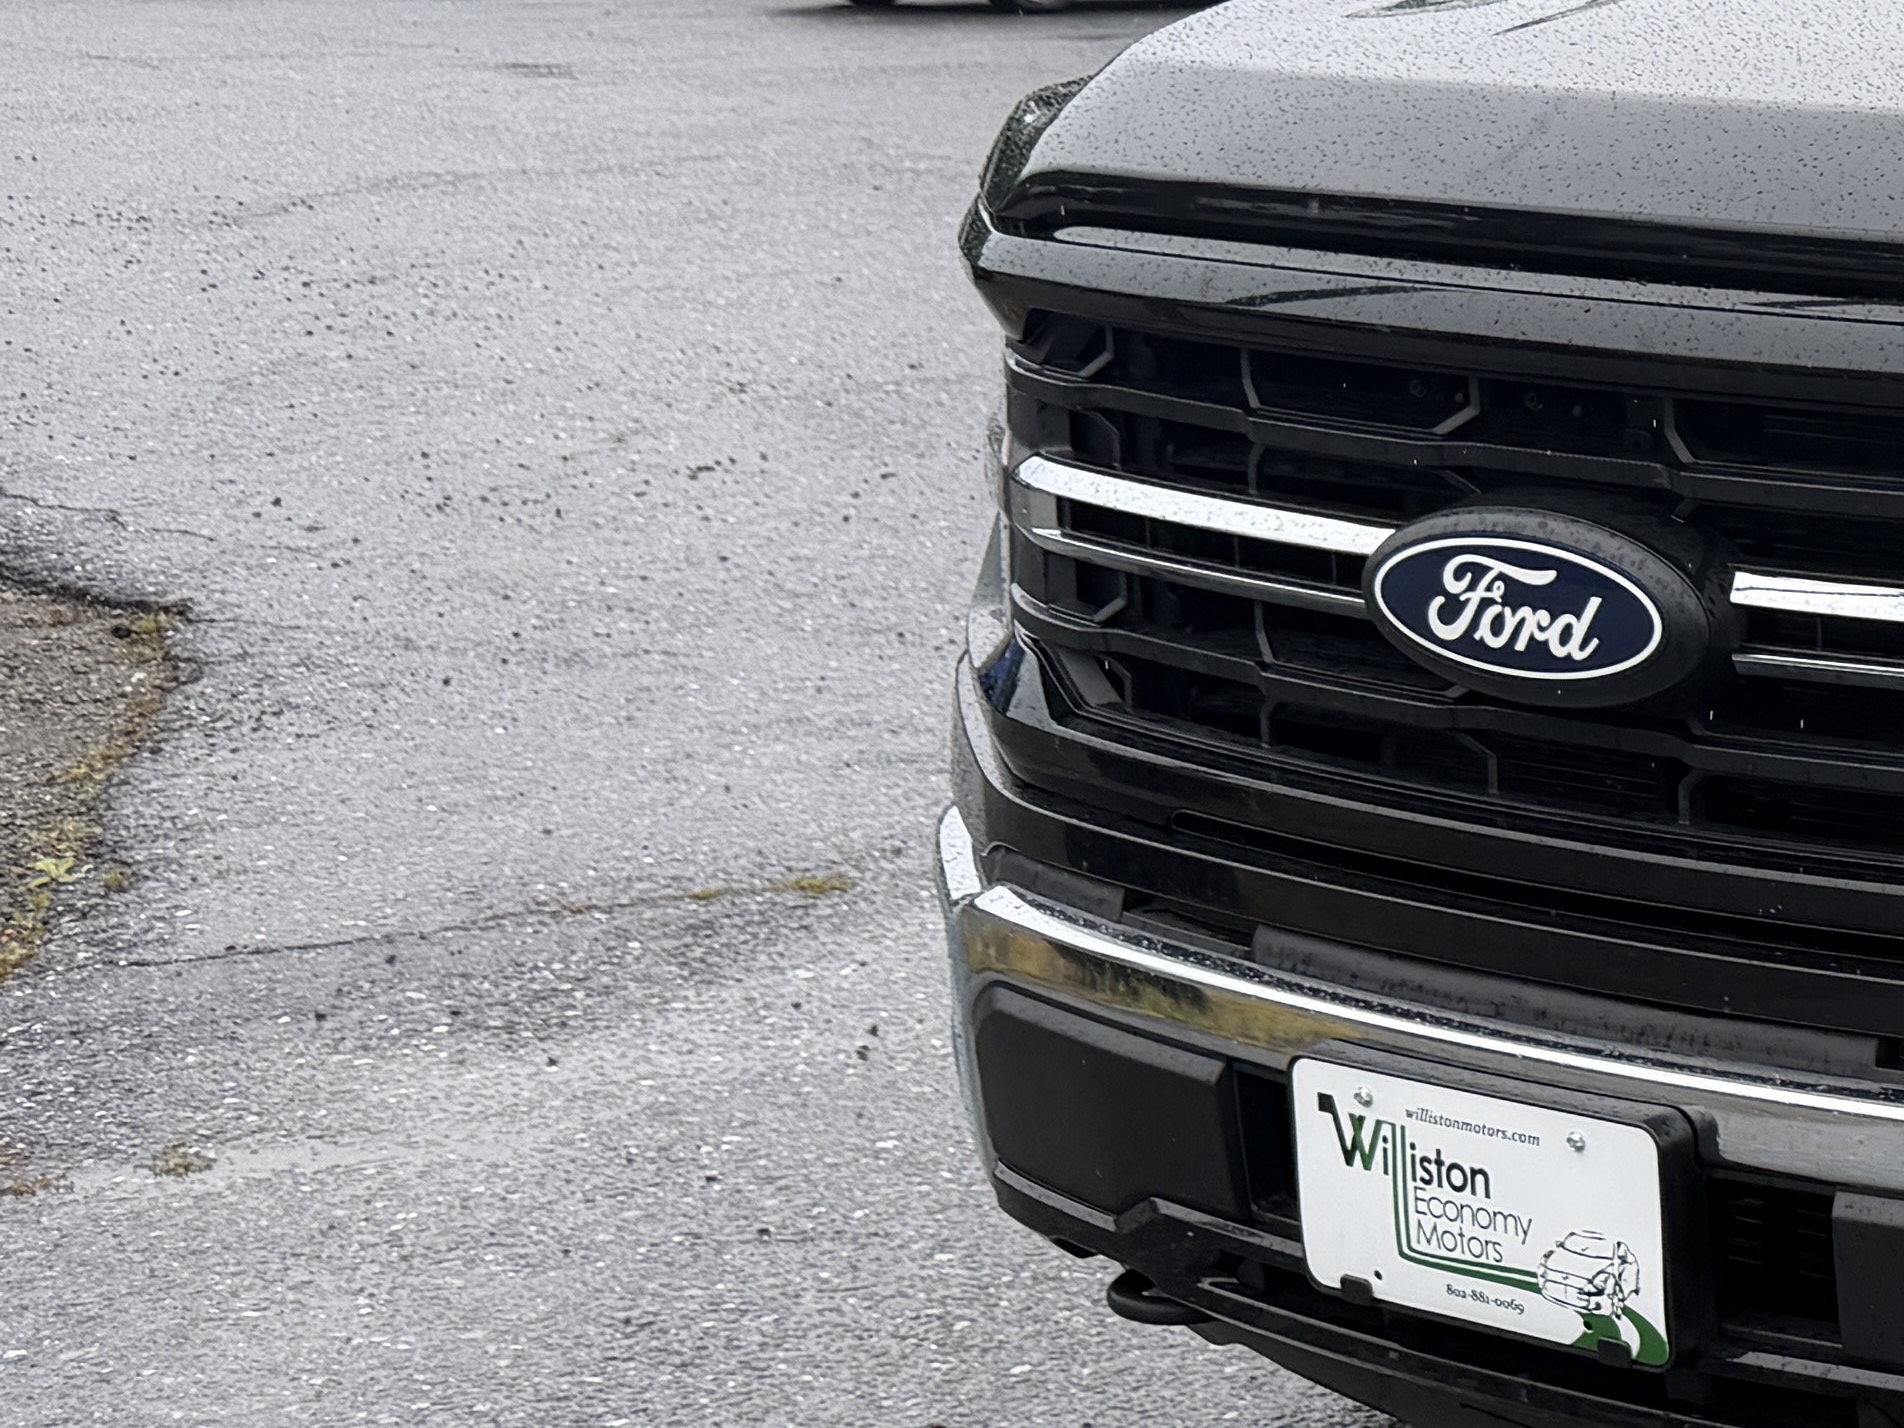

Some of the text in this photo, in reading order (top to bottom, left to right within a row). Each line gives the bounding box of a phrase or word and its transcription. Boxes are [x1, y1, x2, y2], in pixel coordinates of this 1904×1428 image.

[1427, 553, 1603, 662] Ford
[1316, 1091, 1491, 1200] Williston
[1404, 1107, 1541, 1147] willistonmotors.com
[1413, 1185, 1533, 1246] Economy
[1416, 1218, 1504, 1264] Motors
[1445, 1283, 1526, 1316] 802-881-0069
